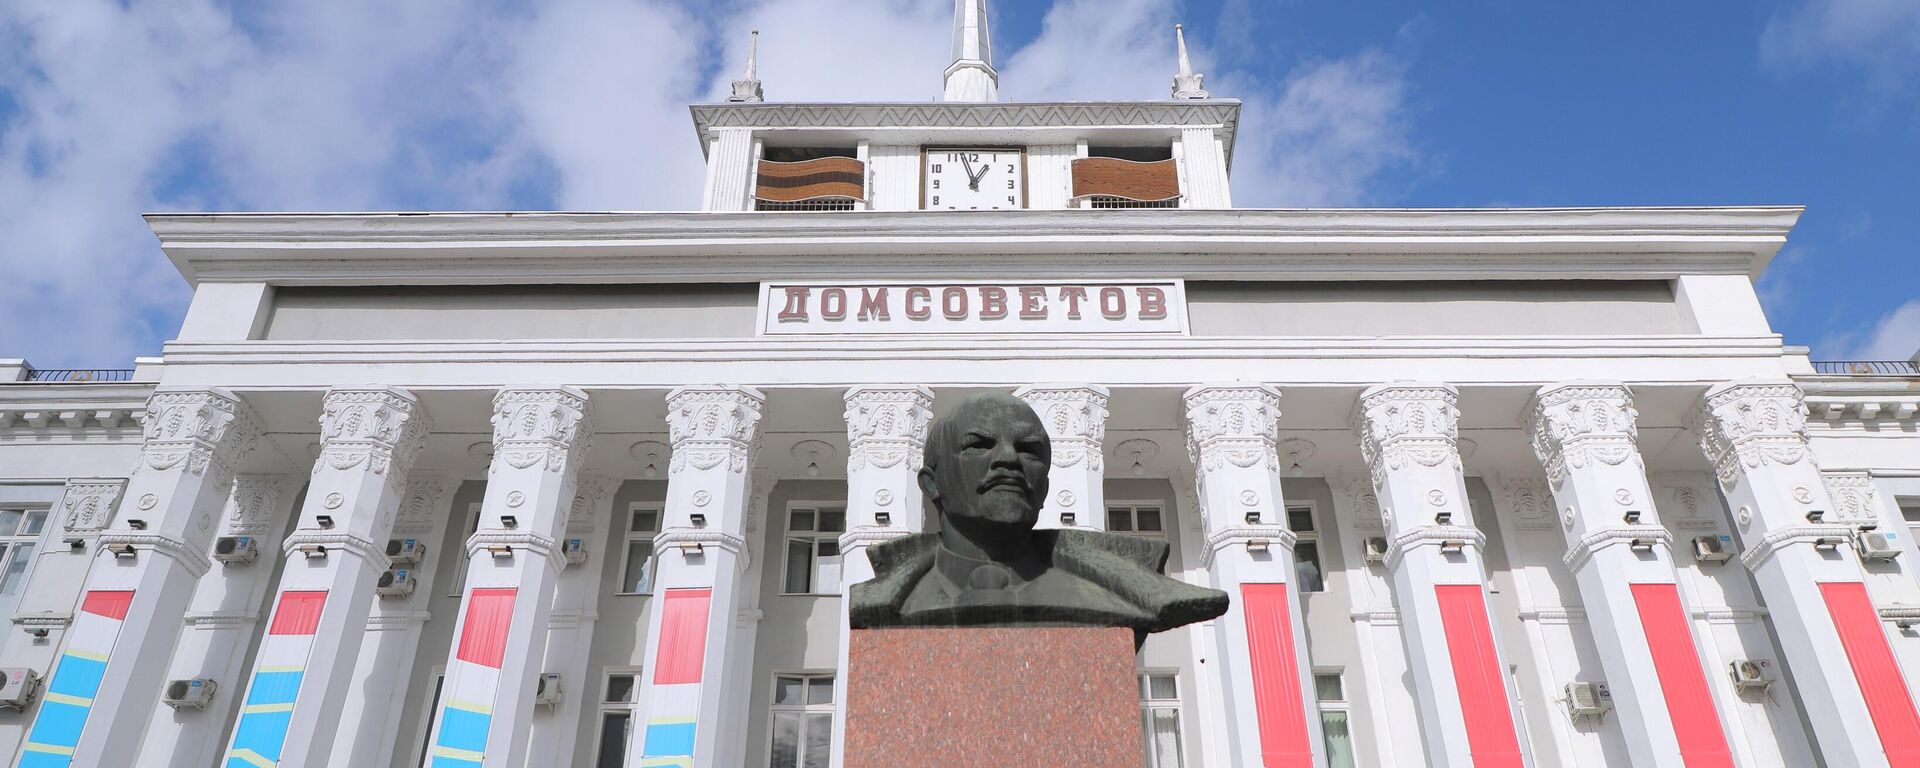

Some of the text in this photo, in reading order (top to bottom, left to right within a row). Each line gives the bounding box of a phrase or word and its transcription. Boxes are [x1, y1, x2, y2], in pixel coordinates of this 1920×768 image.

[947, 154, 958, 162] 11
[968, 154, 979, 162] 12
[931, 164, 942, 173] 10
[1007, 164, 1014, 173] 2
[933, 180, 940, 189] 9
[1007, 180, 1015, 189] 3
[932, 196, 940, 205] 8
[1007, 196, 1015, 205] 4
